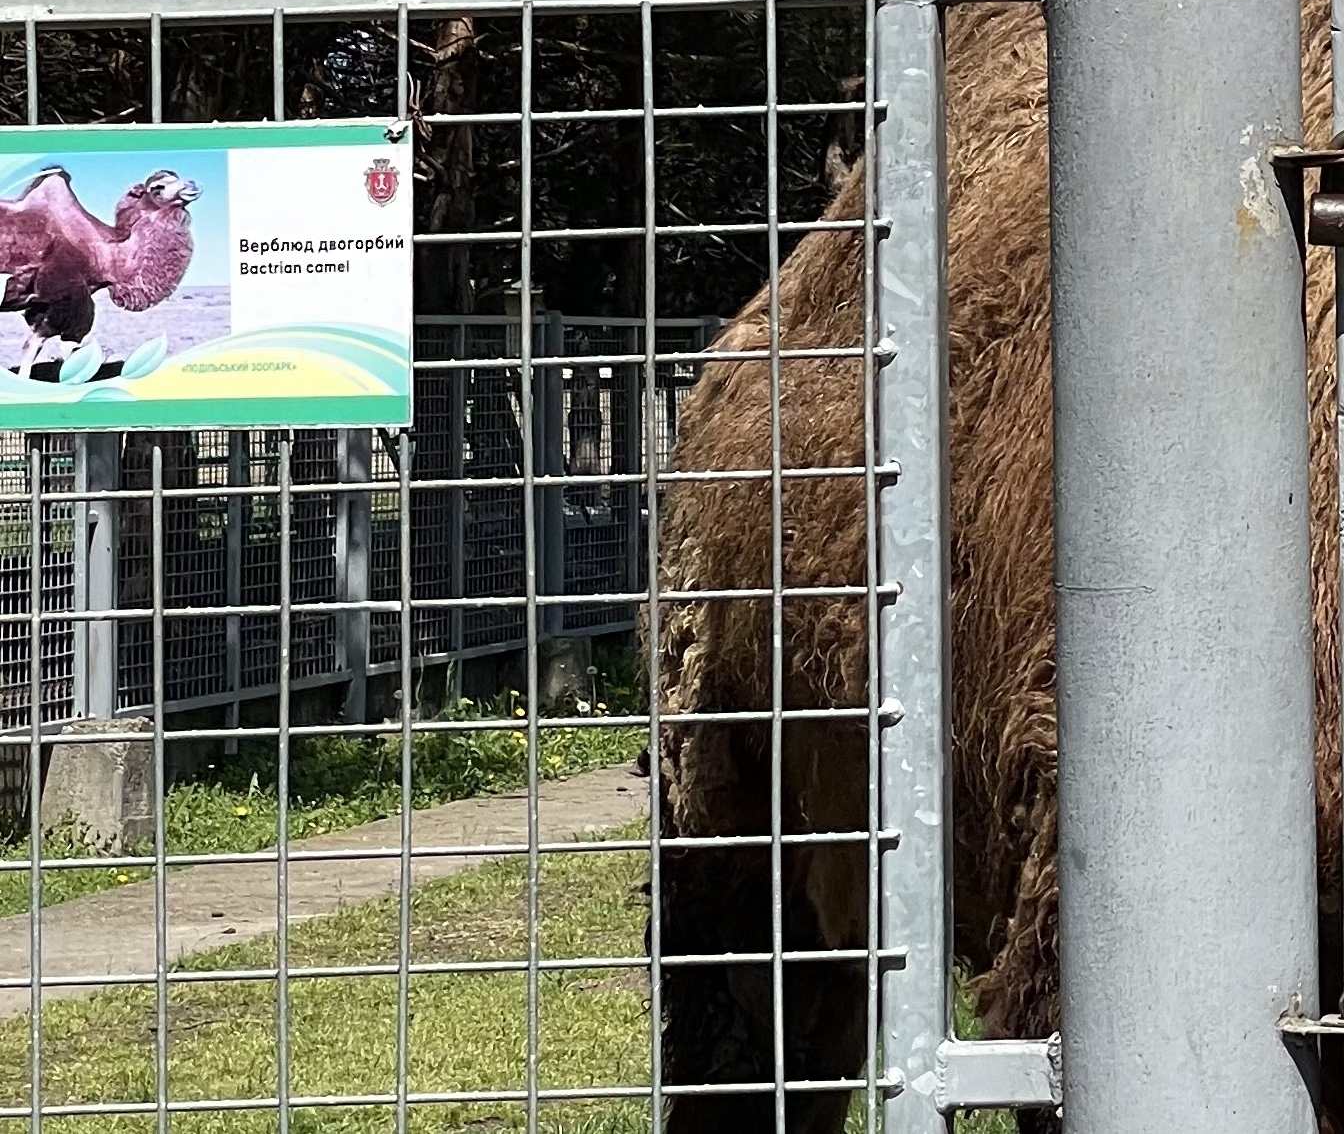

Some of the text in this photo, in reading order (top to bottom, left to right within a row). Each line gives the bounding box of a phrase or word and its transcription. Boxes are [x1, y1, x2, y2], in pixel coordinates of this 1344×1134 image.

[239, 235, 404, 255] Верблюд двогорбий
[240, 260, 350, 275] Bactrian camel
